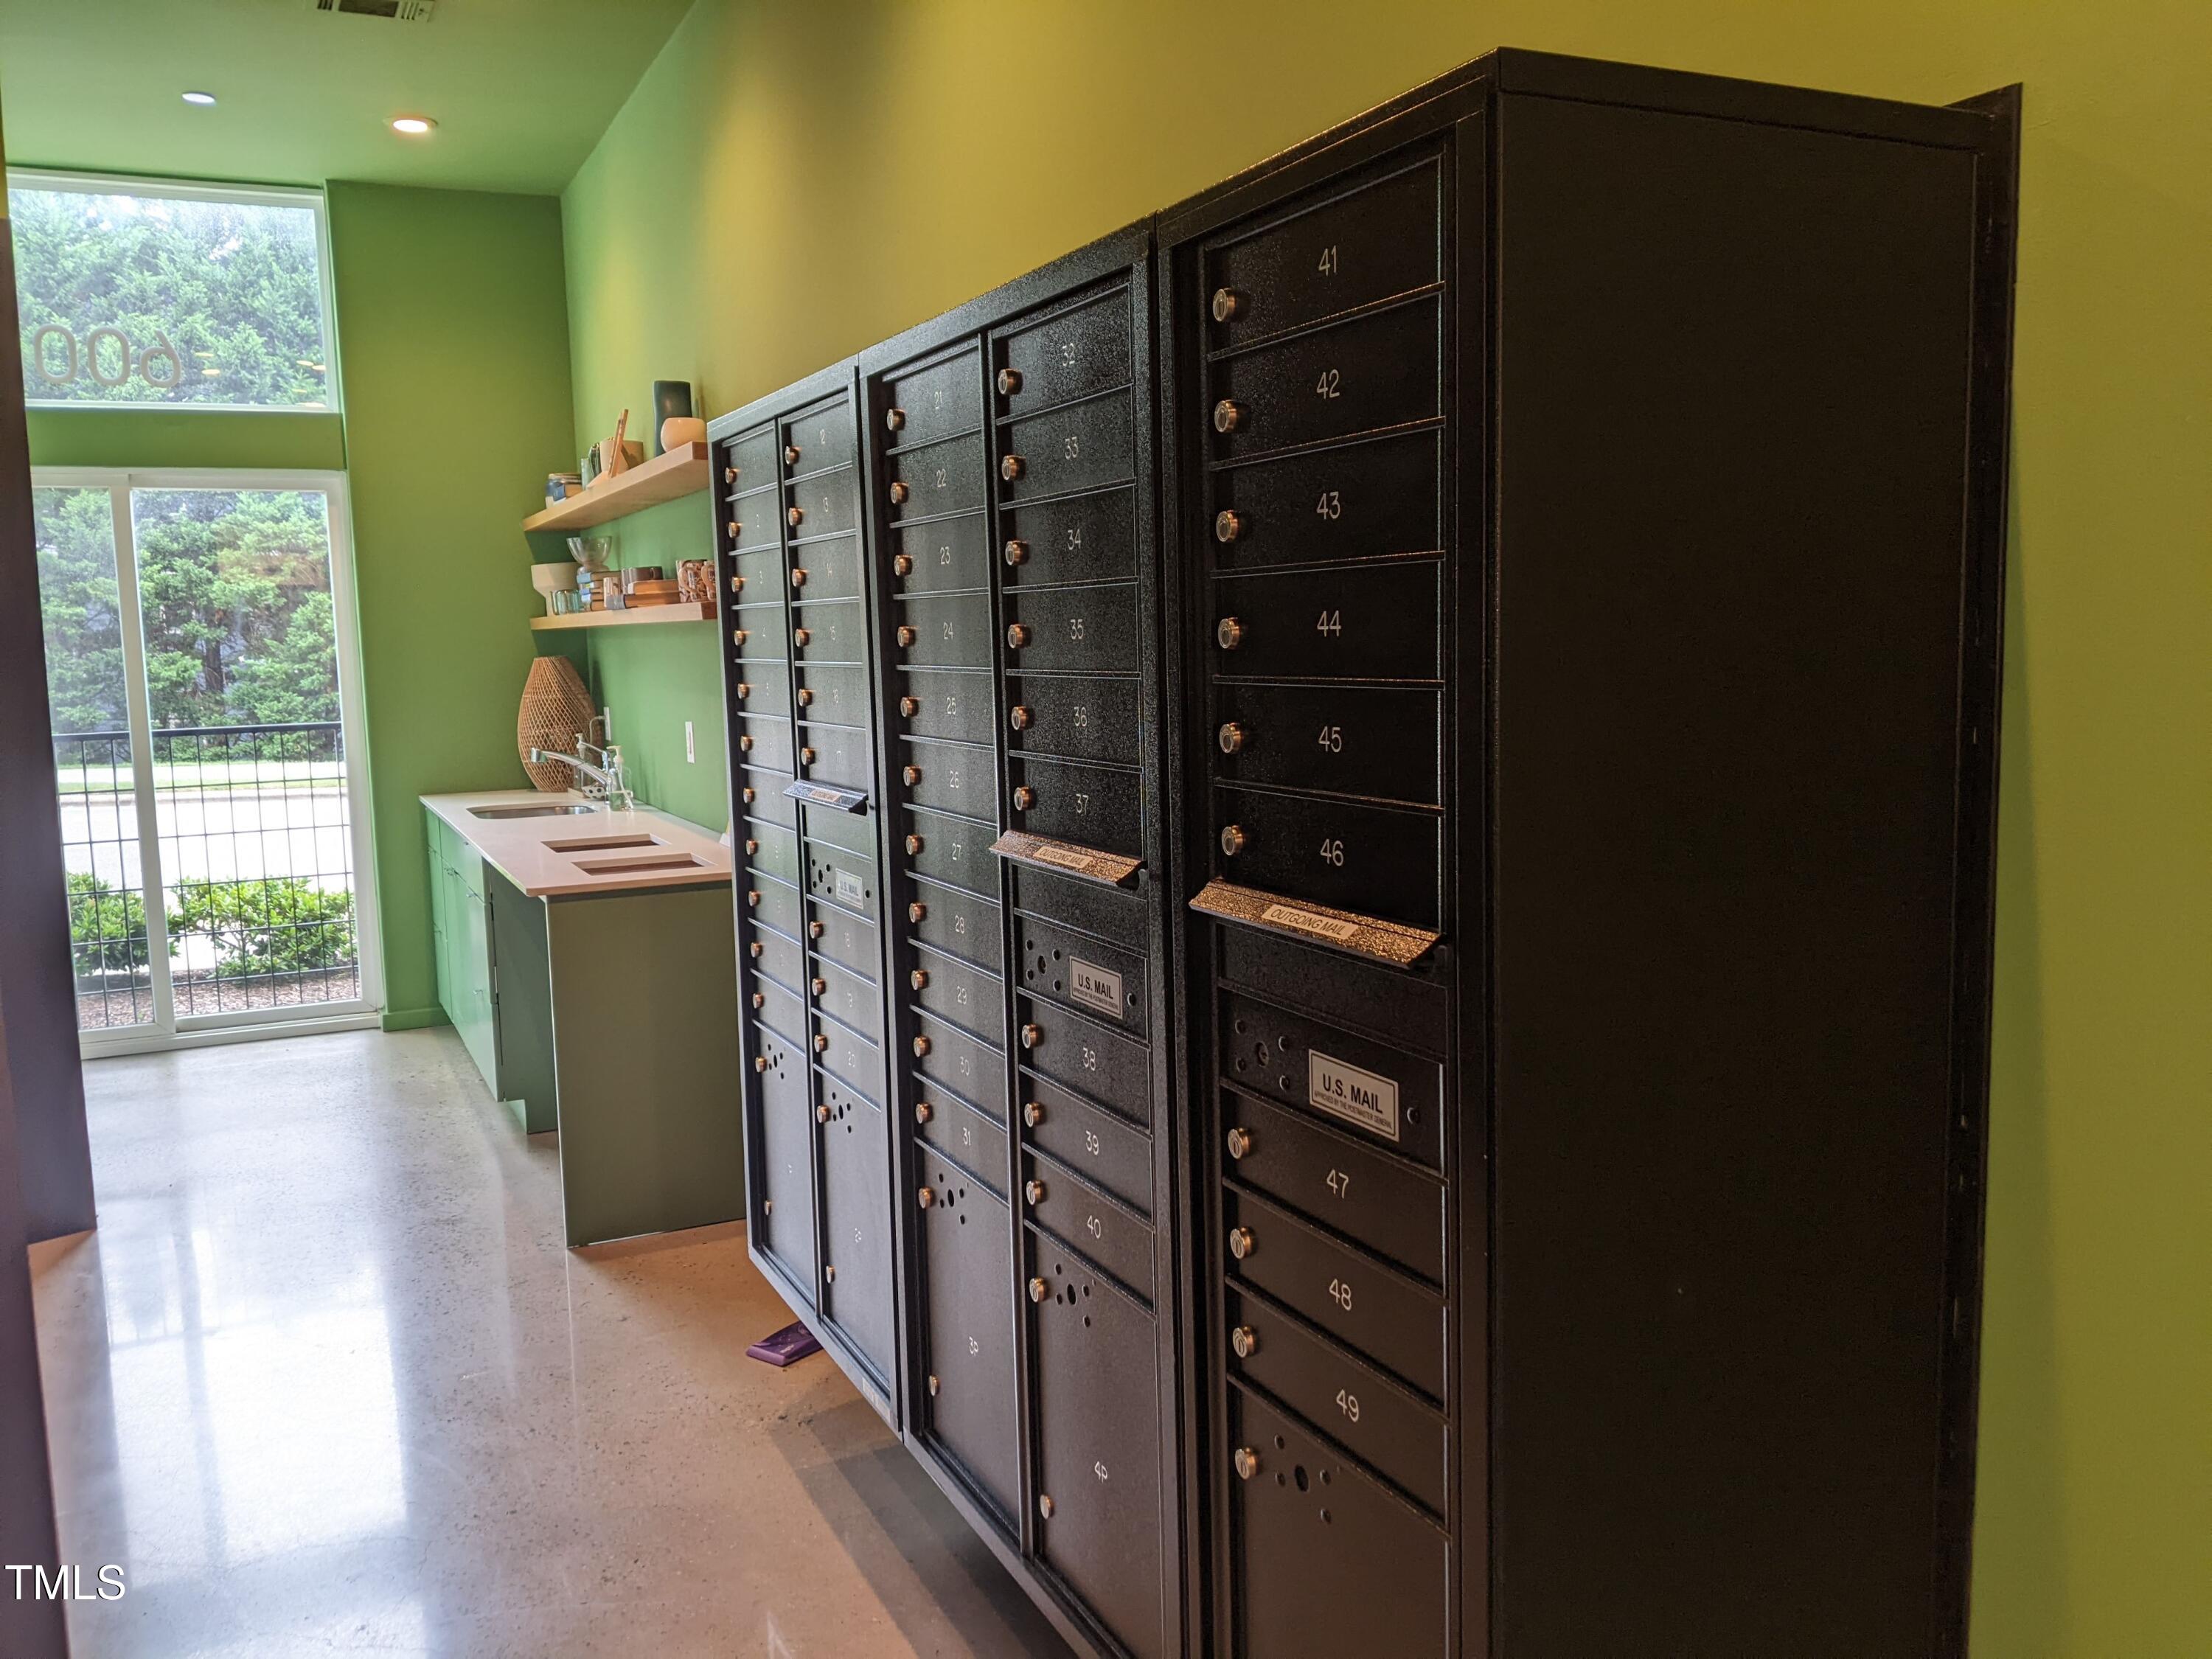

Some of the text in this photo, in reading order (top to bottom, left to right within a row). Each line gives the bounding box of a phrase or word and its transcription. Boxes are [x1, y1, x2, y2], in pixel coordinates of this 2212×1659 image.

[1318, 245, 1338, 276] 41
[1062, 342, 1076, 367] 32
[1316, 369, 1340, 400] 42
[933, 390, 942, 410] 21
[818, 428, 826, 445] 12
[1065, 436, 1079, 460] 33
[936, 468, 947, 488] 22
[1316, 491, 1340, 520] 43
[1067, 528, 1082, 551] 34
[939, 546, 950, 565] 23
[943, 622, 954, 640] 24
[1070, 619, 1084, 640] 35
[1317, 610, 1342, 637] 44
[946, 697, 956, 715] 25
[1074, 706, 1088, 727] 36
[1318, 726, 1342, 753] 45
[950, 770, 960, 789] 26
[1075, 793, 1089, 814] 37
[952, 843, 961, 860] 27
[1039, 848, 1085, 866] OUTGOING MAIL
[1320, 838, 1344, 866] 46
[955, 914, 965, 934] 28
[1270, 908, 1346, 936] OUTGOING MAIL
[956, 985, 967, 1005] 29
[1078, 973, 1113, 999] U.S. MAIL
[959, 1056, 970, 1077] 30
[1082, 1047, 1096, 1071] 38
[1323, 1073, 1382, 1114] U.S. MAIL
[962, 1127, 971, 1147] 31
[1085, 1130, 1099, 1155] 39
[1326, 1169, 1349, 1199] 47
[1087, 1214, 1102, 1239] 40
[1329, 1279, 1352, 1311] 48
[1336, 1389, 1360, 1422] 49
[1094, 1461, 1108, 1484] 4P
